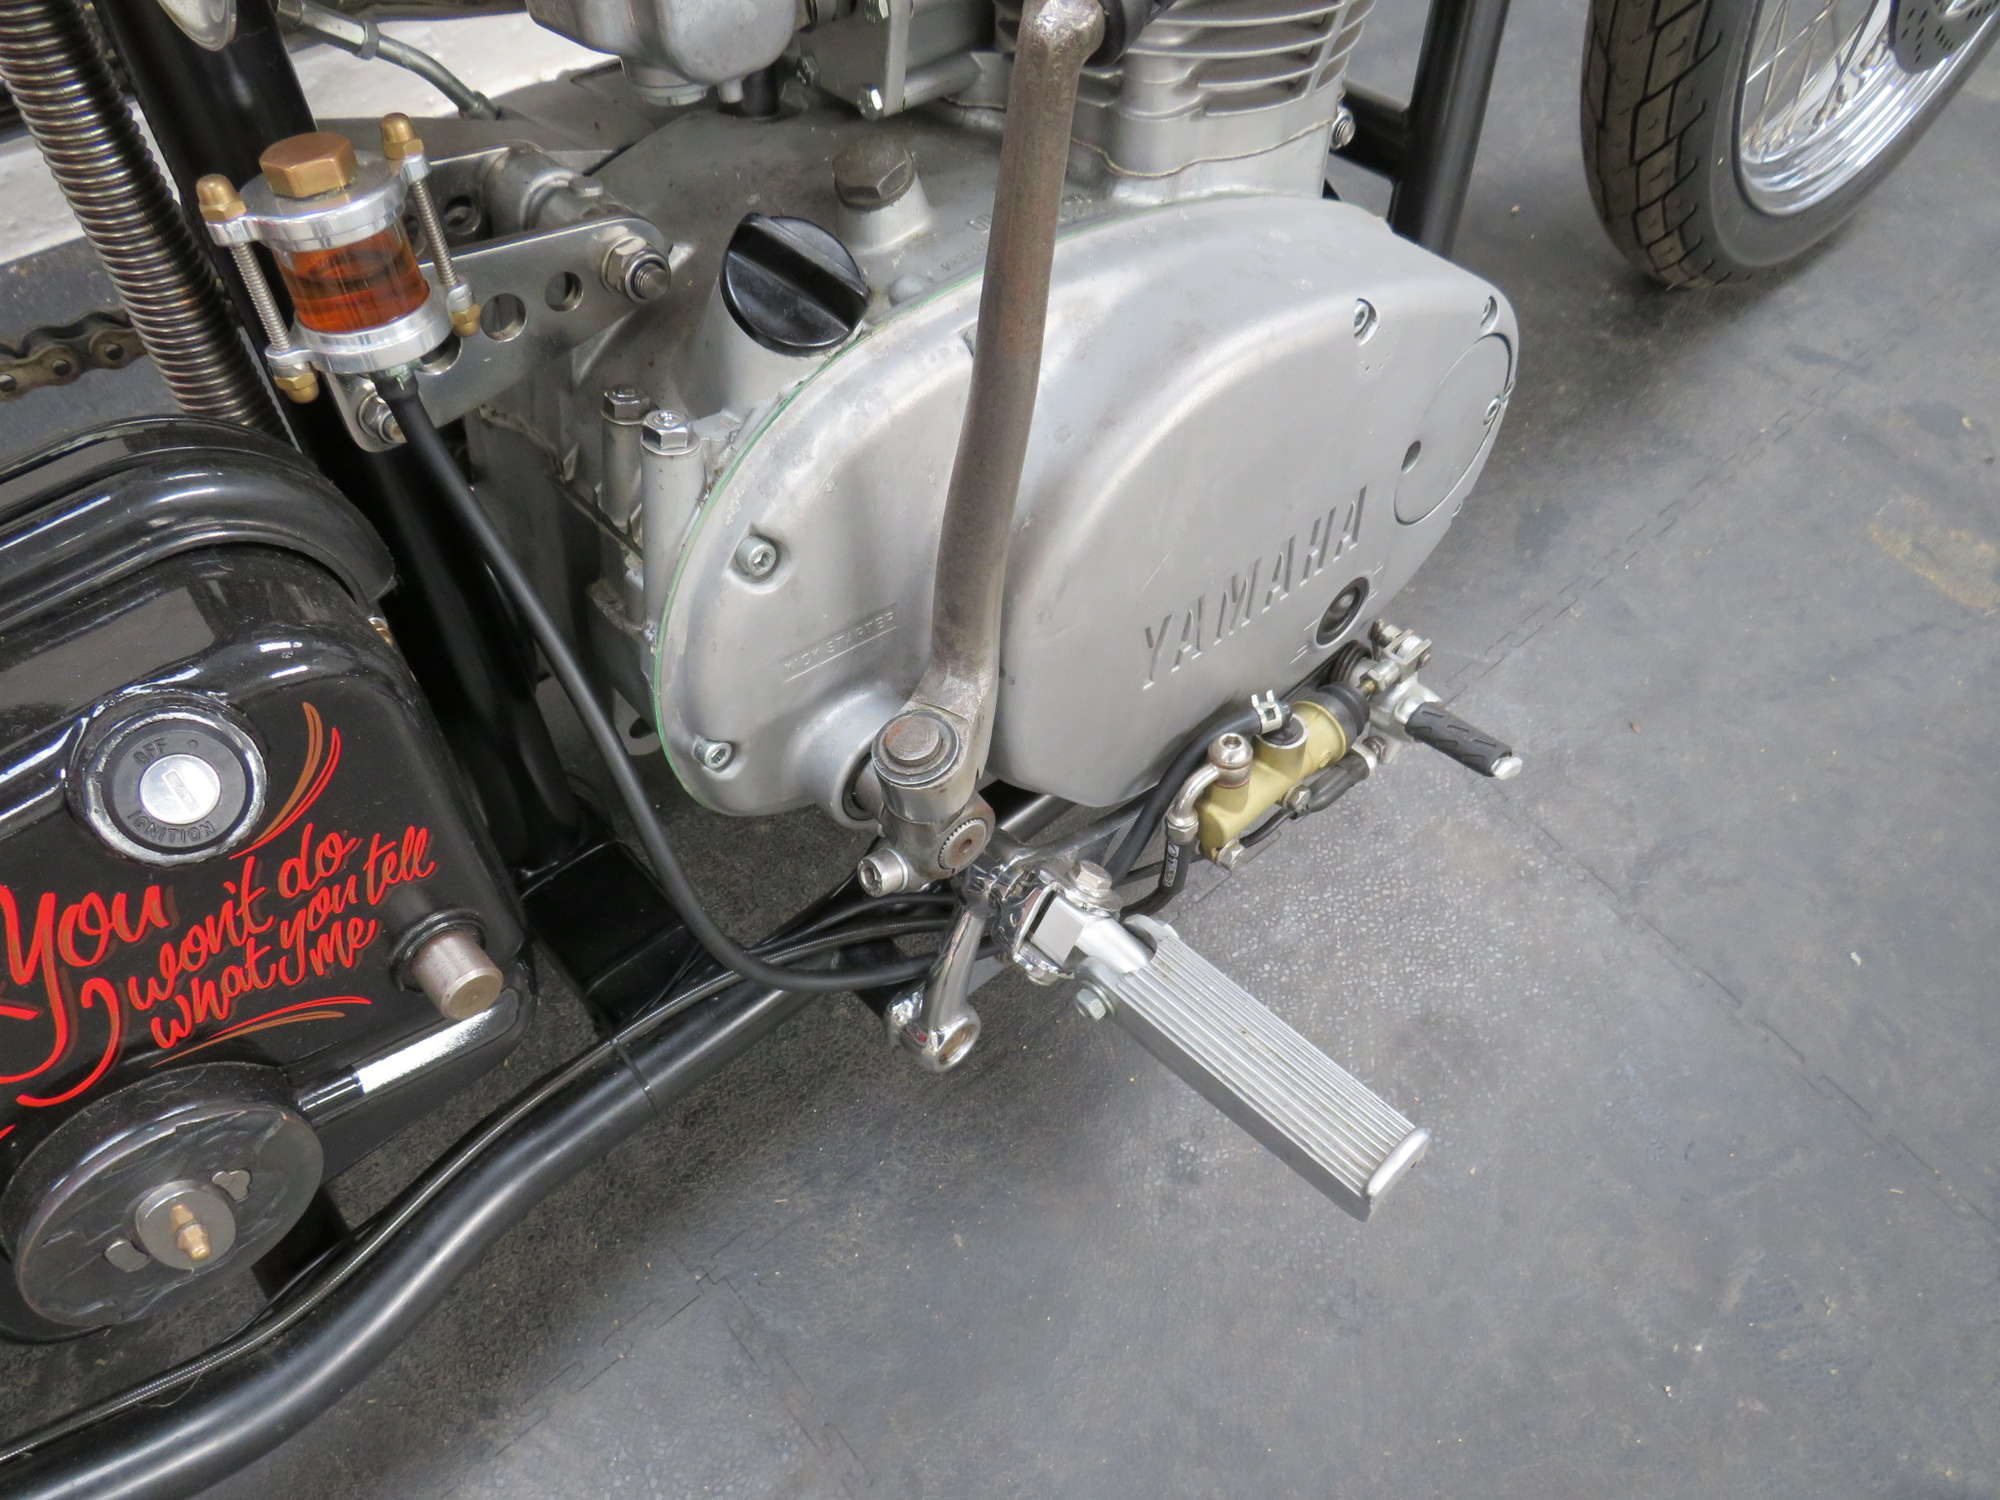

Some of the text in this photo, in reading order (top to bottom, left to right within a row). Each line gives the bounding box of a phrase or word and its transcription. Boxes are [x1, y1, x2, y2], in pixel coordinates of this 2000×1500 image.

[1142, 485, 1367, 691] YAMAHA
[133, 737, 168, 765] OFF
[126, 809, 217, 843] IGNITION
[279, 823, 361, 901] do
[151, 826, 437, 1050] what you tell
[310, 917, 378, 977] me
[0, 884, 170, 1085] You
